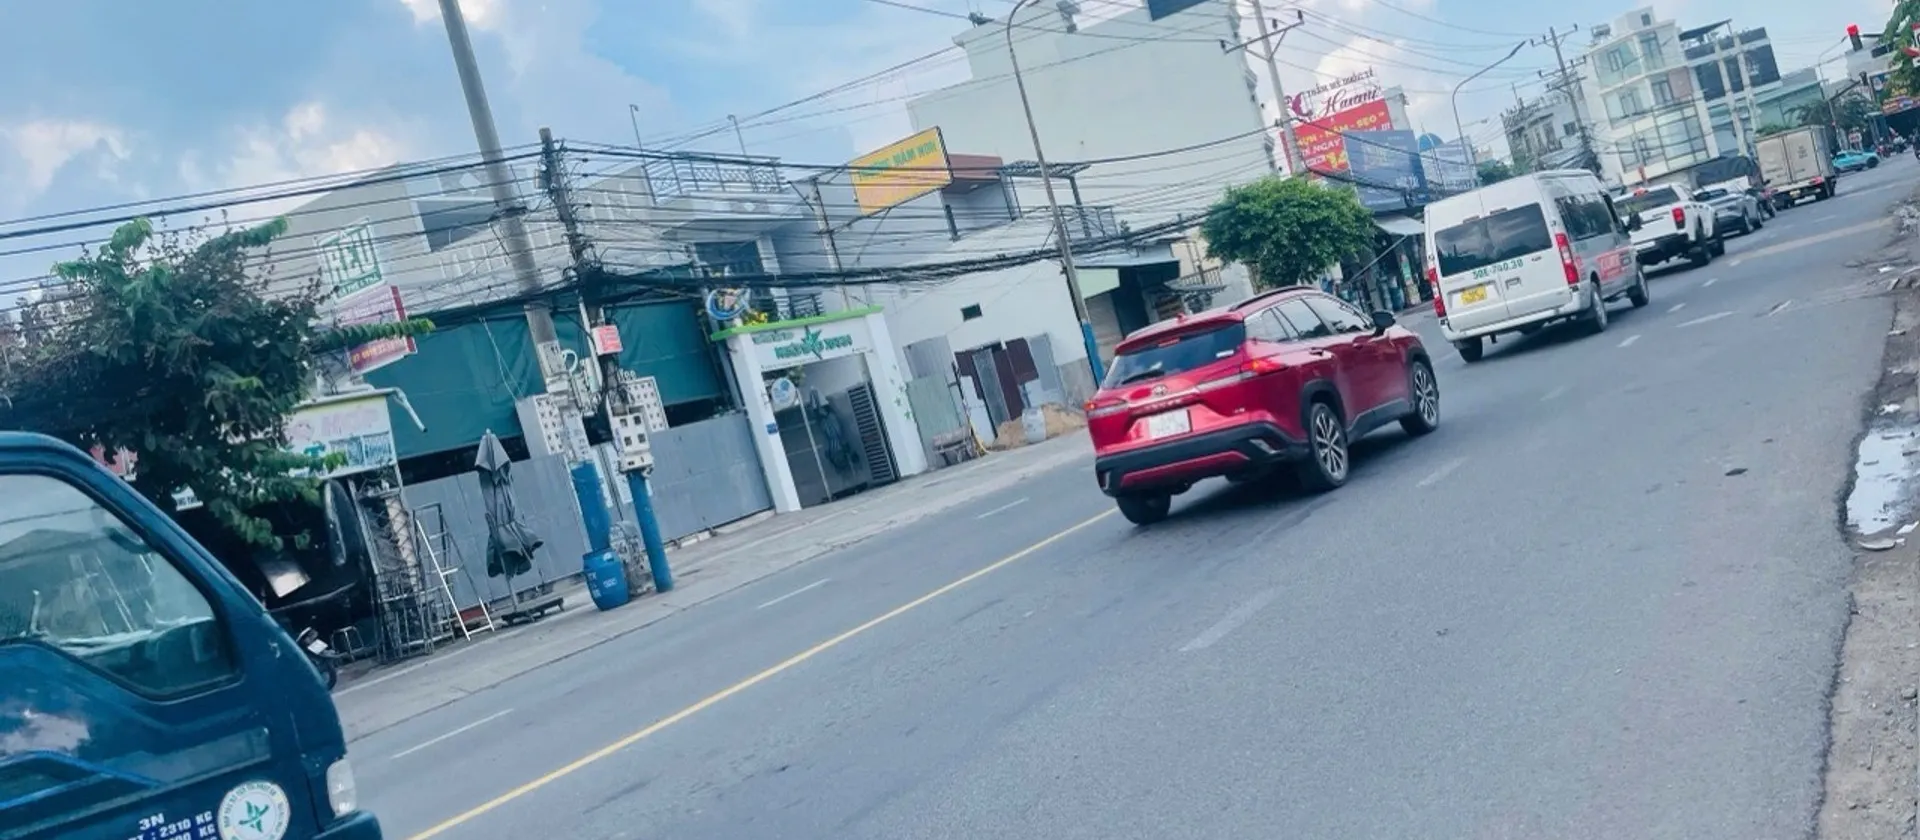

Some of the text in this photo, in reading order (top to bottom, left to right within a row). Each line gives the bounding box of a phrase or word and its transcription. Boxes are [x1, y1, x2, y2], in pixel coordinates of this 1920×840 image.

[159, 818, 192, 838] 2310
[195, 810, 213, 825] KG
[199, 823, 216, 838] KG
